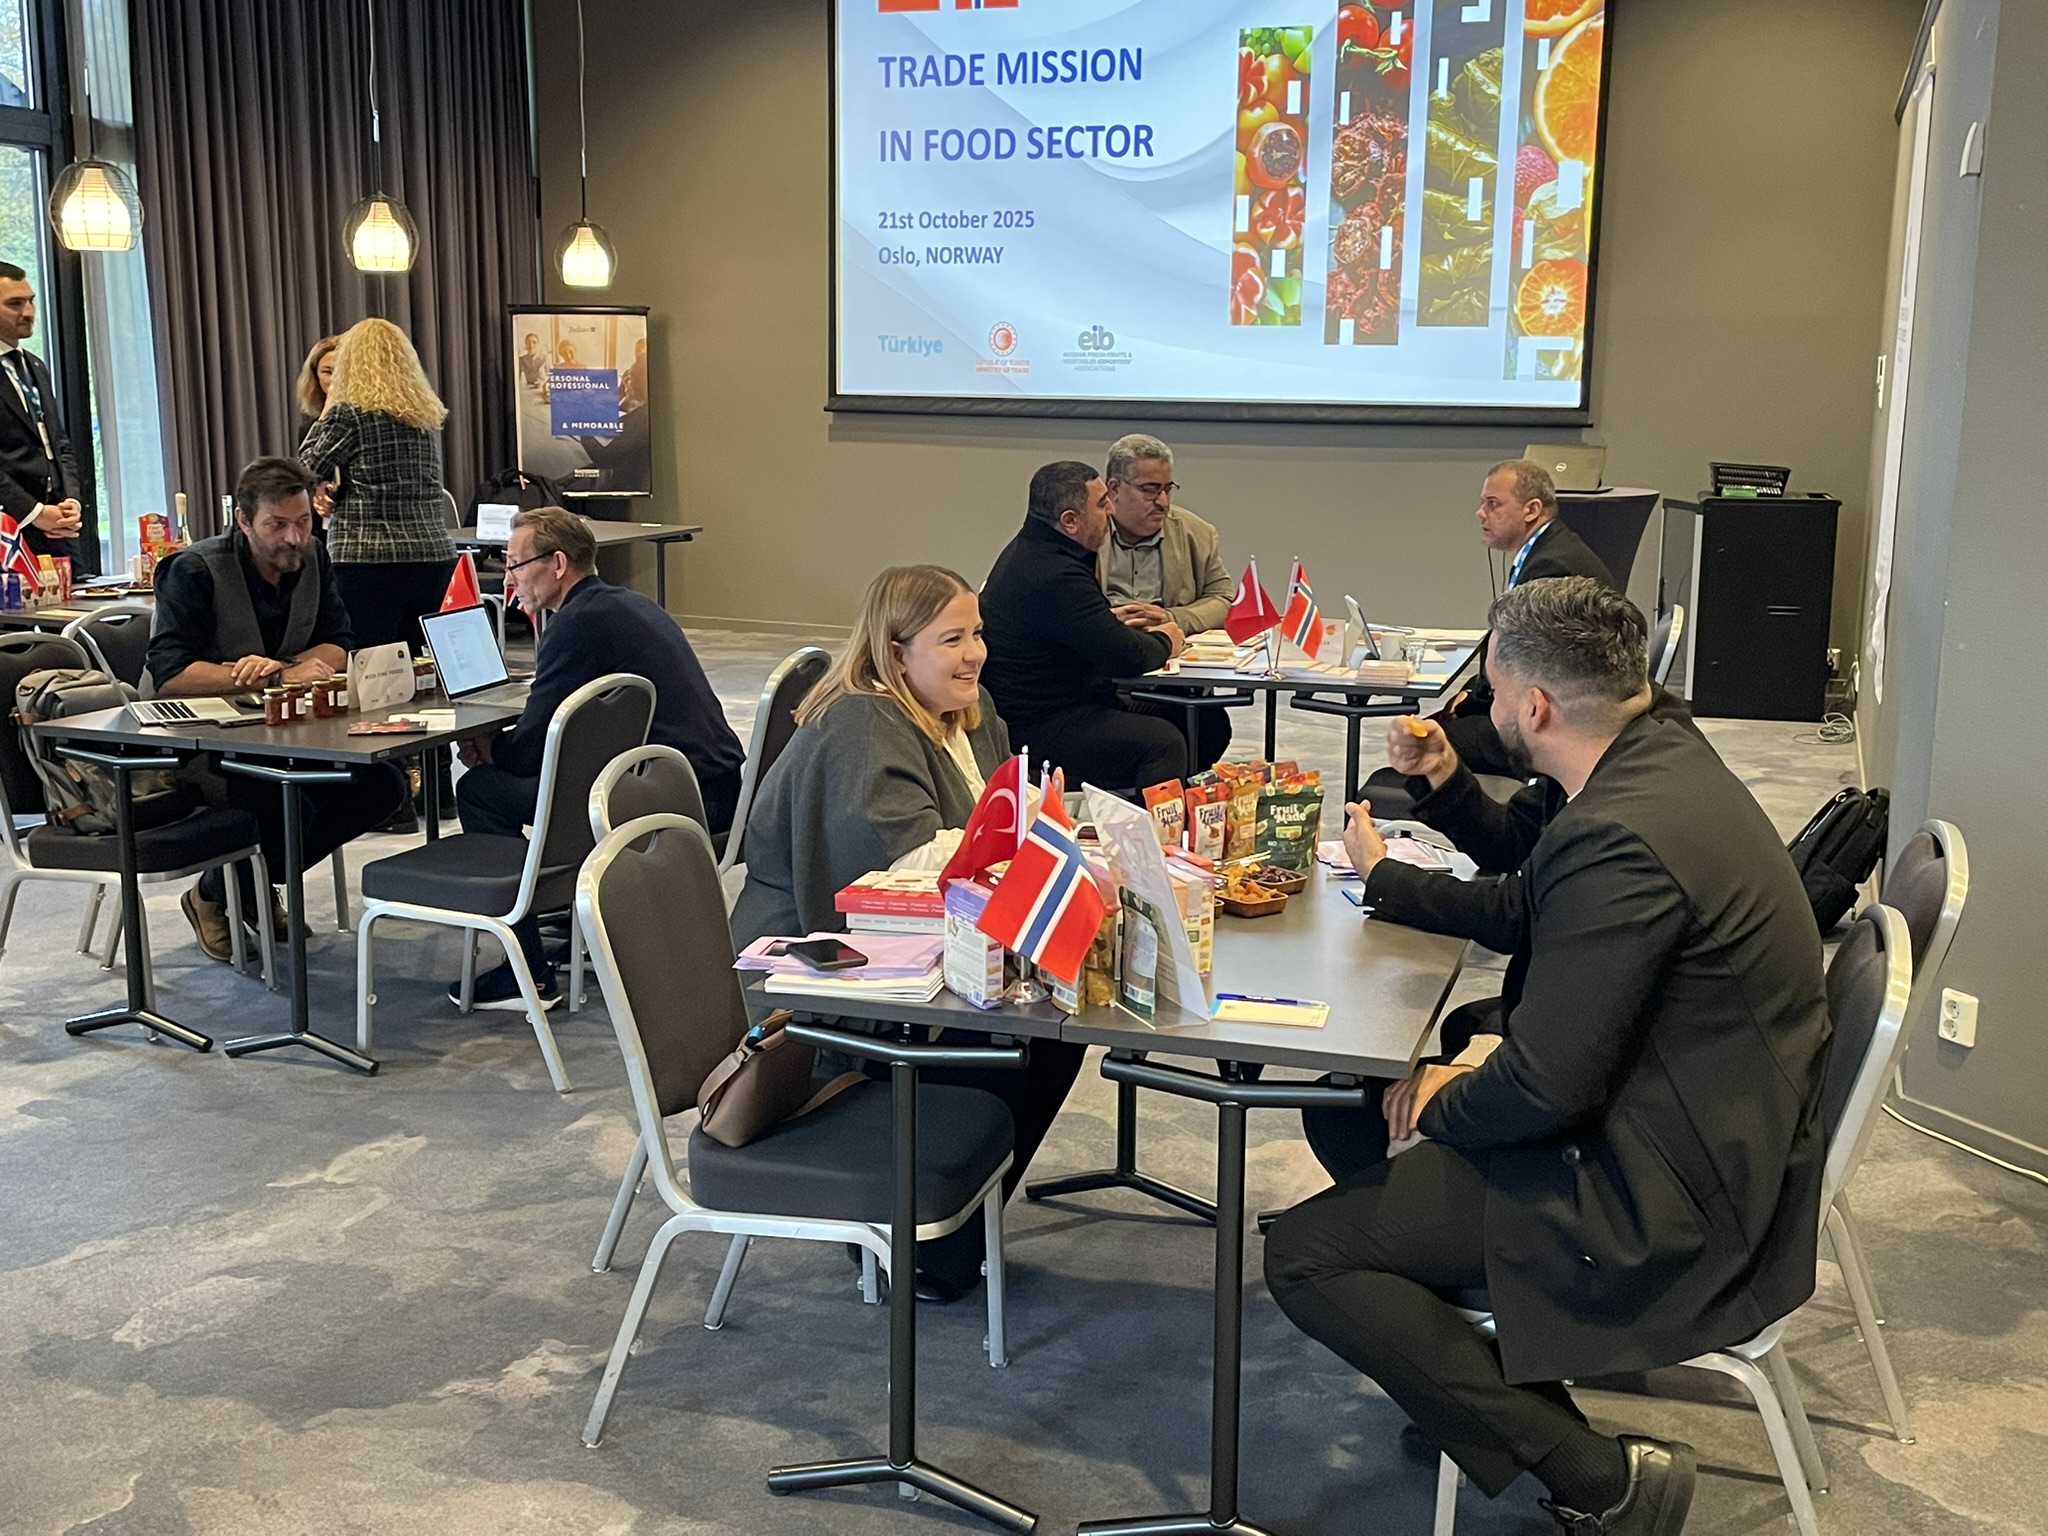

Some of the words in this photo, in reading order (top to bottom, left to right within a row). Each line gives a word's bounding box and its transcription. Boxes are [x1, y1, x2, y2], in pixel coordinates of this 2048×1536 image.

[878, 53, 986, 88] TRADE
[997, 47, 1143, 85] MISSION
[880, 130, 912, 162] IN
[924, 128, 1016, 161] FOOD
[1026, 124, 1154, 160] SECTOR
[878, 211, 914, 229] 21st
[918, 210, 988, 229] October
[992, 210, 1035, 228] 2025
[878, 246, 921, 267] Oslo,
[926, 246, 1004, 264] NORWAY
[878, 334, 943, 357] Türkiye
[1078, 325, 1114, 350] eib
[571, 422, 624, 430] MEMORABLE
[1156, 803, 1178, 818] Fruit
[1270, 803, 1299, 816] Fruit
[1273, 810, 1307, 824] Made
